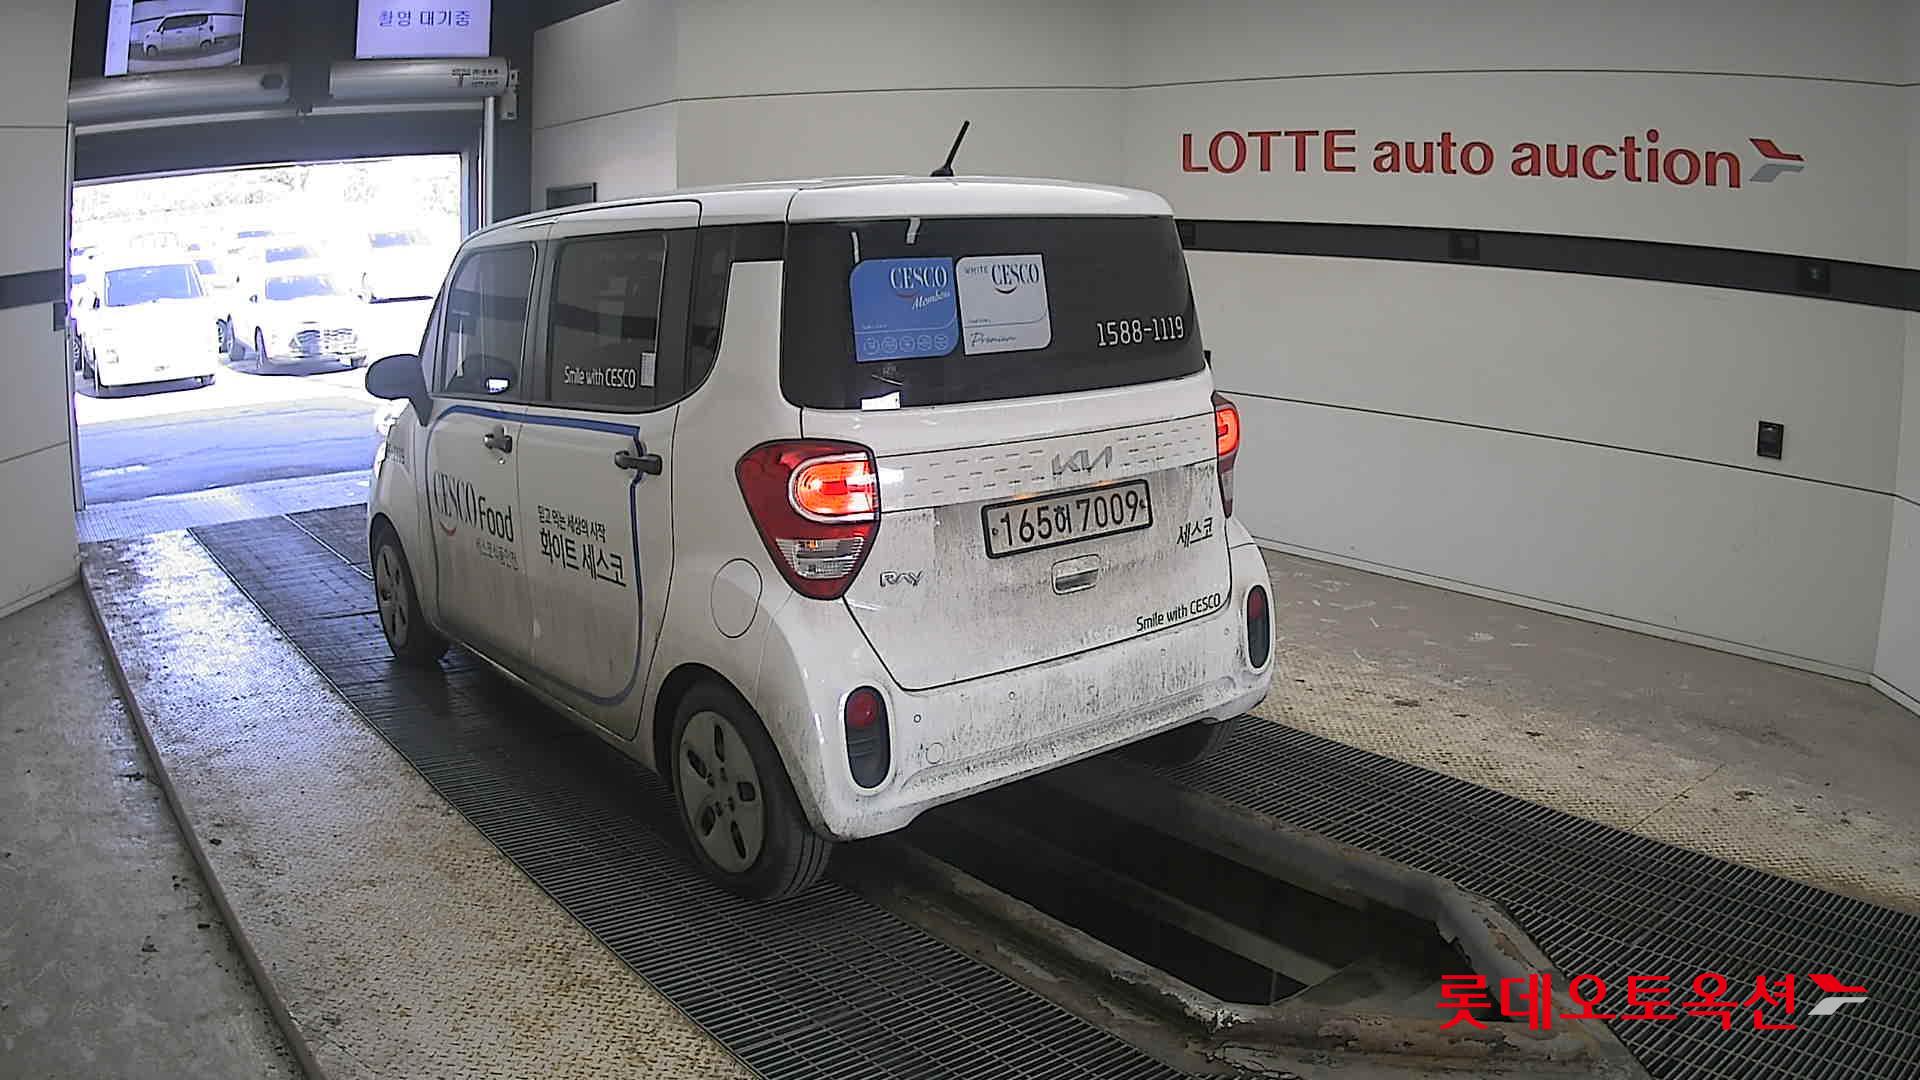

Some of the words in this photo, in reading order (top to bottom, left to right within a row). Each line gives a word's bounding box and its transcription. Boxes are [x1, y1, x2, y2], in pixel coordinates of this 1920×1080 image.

[419, 9, 471, 28] 대기중
[1182, 129, 1357, 174] LOTTE
[1372, 132, 1495, 176] auto
[1510, 129, 1742, 188] auction
[890, 265, 948, 289] CESCO
[990, 263, 1040, 286] CESCO
[1096, 315, 1184, 347] 1588-1119
[563, 365, 585, 386] Smile
[585, 367, 604, 386] with
[604, 367, 637, 389] CESCO
[433, 471, 477, 528] CESCO
[478, 495, 514, 543] Food
[590, 521, 606, 543] 시작
[1176, 517, 1214, 549] 세스코
[539, 527, 580, 570] 화이트
[582, 543, 627, 588] 세스코
[879, 570, 924, 588] RAY
[1136, 611, 1165, 632] Smile
[1165, 604, 1189, 622] with
[1190, 592, 1222, 615] CESCO
